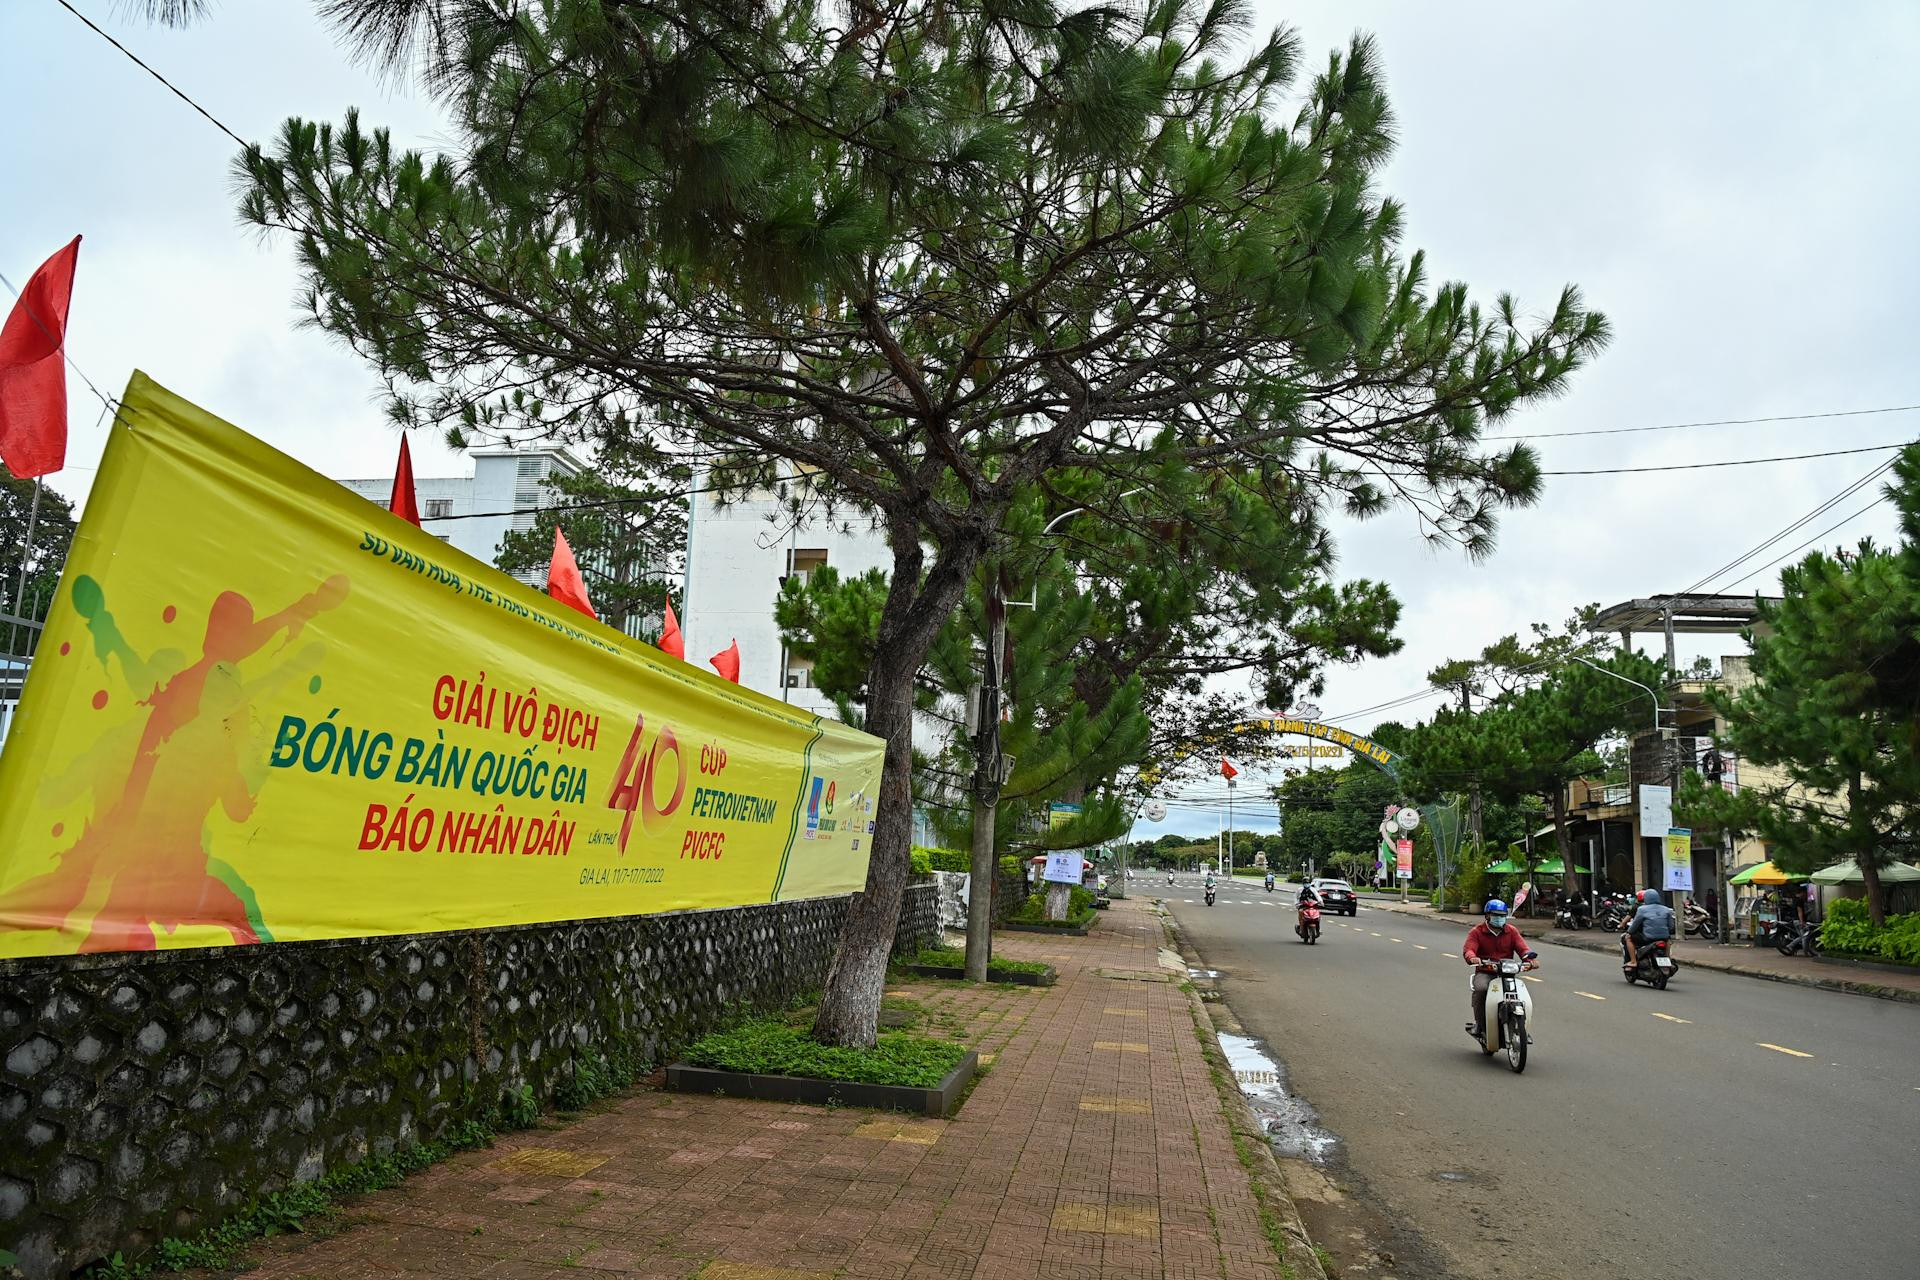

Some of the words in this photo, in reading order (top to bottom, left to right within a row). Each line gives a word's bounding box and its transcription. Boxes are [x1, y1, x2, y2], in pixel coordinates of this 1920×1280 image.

[432, 671, 496, 729] GIẢI
[503, 687, 539, 738] VÔ
[542, 703, 600, 754] ĐỊCH
[269, 708, 394, 780] BÓNG
[395, 729, 471, 789] BÀN
[471, 744, 549, 799] QUỐC
[550, 764, 587, 804] GIA
[700, 739, 727, 777] CÚP
[1372, 746, 1392, 766] LAI
[358, 793, 434, 852] BÁO
[436, 804, 524, 855] NHÂN
[521, 810, 576, 856] DÂN
[691, 787, 777, 825] PETROVIETNAM
[680, 830, 726, 861] PVCFC
[580, 868, 595, 885] GIA
[595, 868, 611, 887] LAI,
[612, 868, 665, 885] 11/7-17/7/2022
